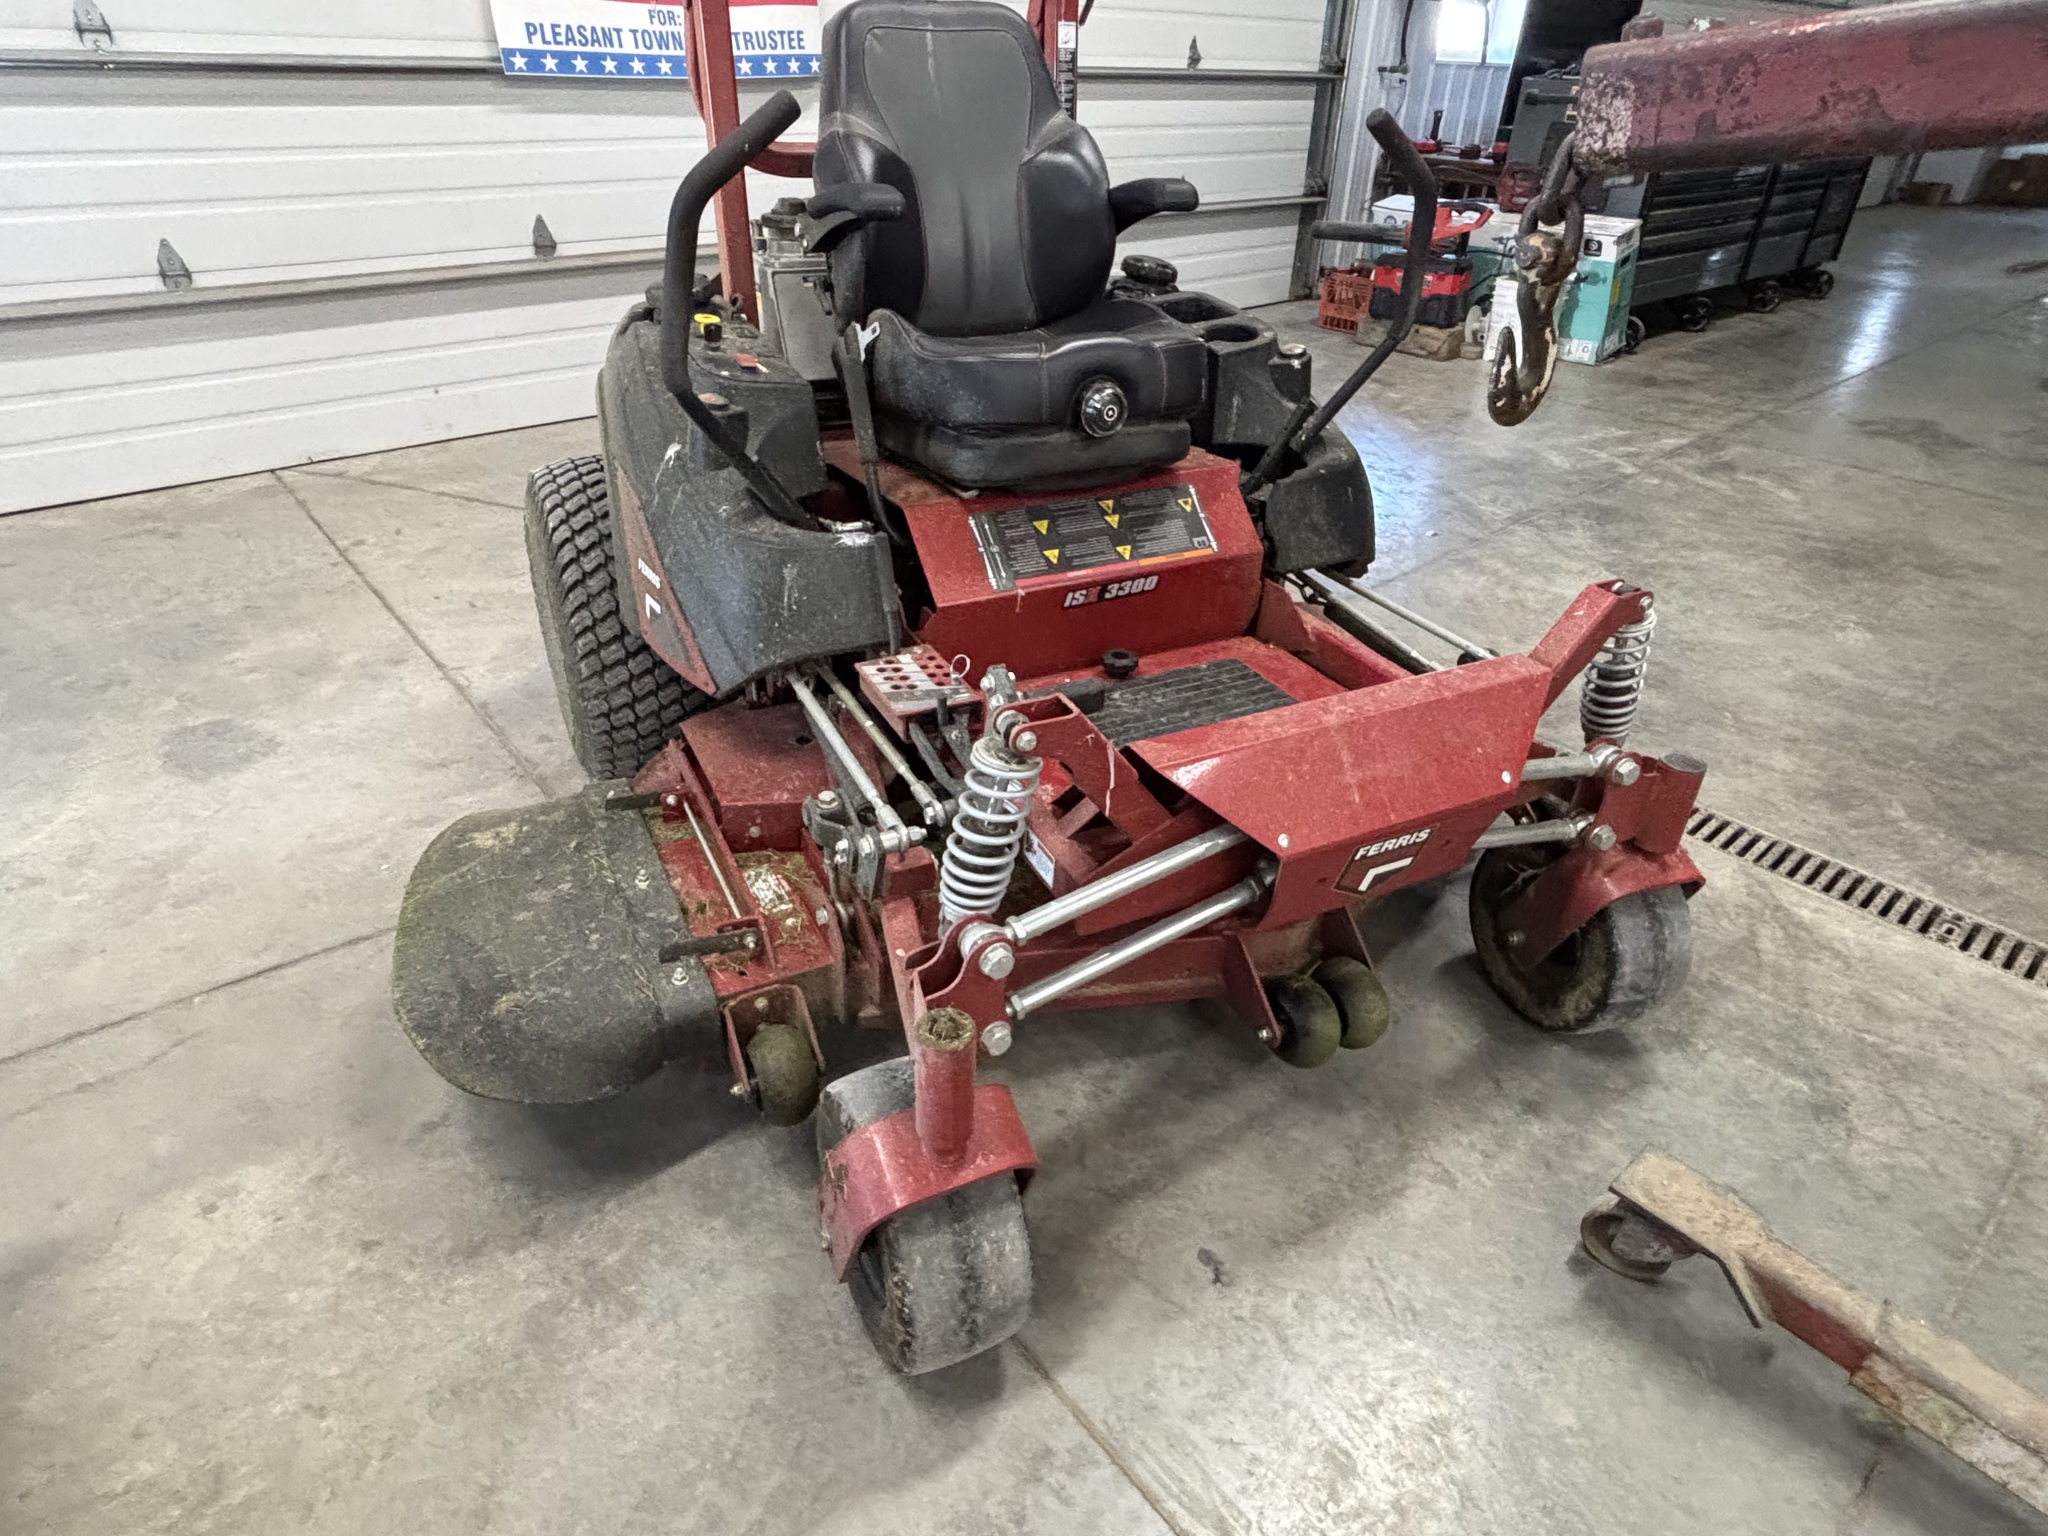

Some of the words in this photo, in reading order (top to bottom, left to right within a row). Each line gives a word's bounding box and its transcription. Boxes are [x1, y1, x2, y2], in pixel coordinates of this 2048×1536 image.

[648, 9, 682, 26] FOR:
[524, 22, 624, 49] PLEASANT
[628, 28, 684, 51] TOWN
[732, 30, 805, 51] TRUSTEE
[1354, 828, 1431, 860] FERRIS
